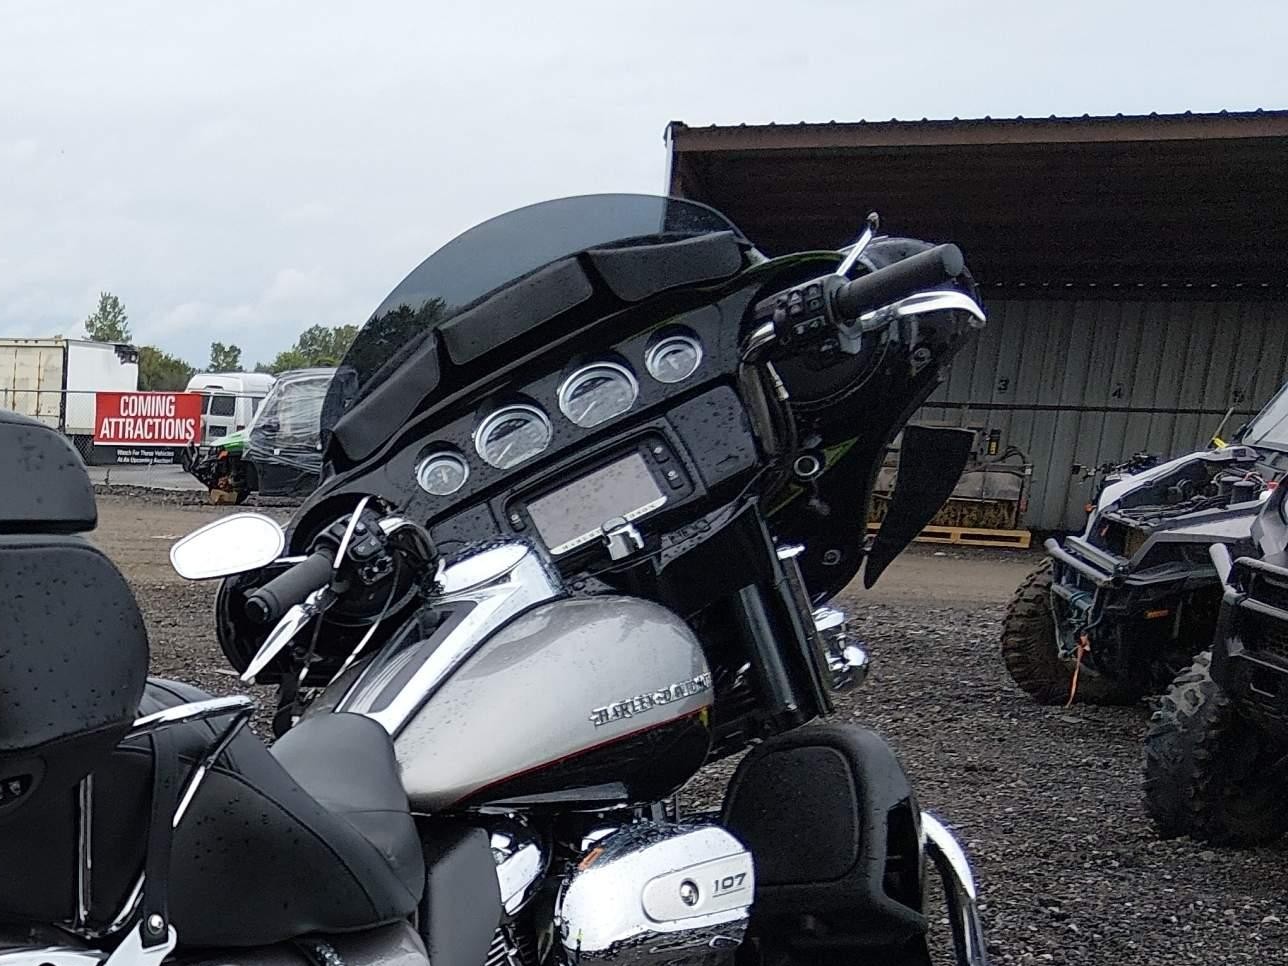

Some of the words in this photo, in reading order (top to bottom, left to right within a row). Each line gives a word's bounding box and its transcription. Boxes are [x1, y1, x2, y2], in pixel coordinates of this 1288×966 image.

[120, 395, 176, 417] COMING
[99, 418, 195, 440] ATTRACTIONS
[715, 872, 747, 892] 107
